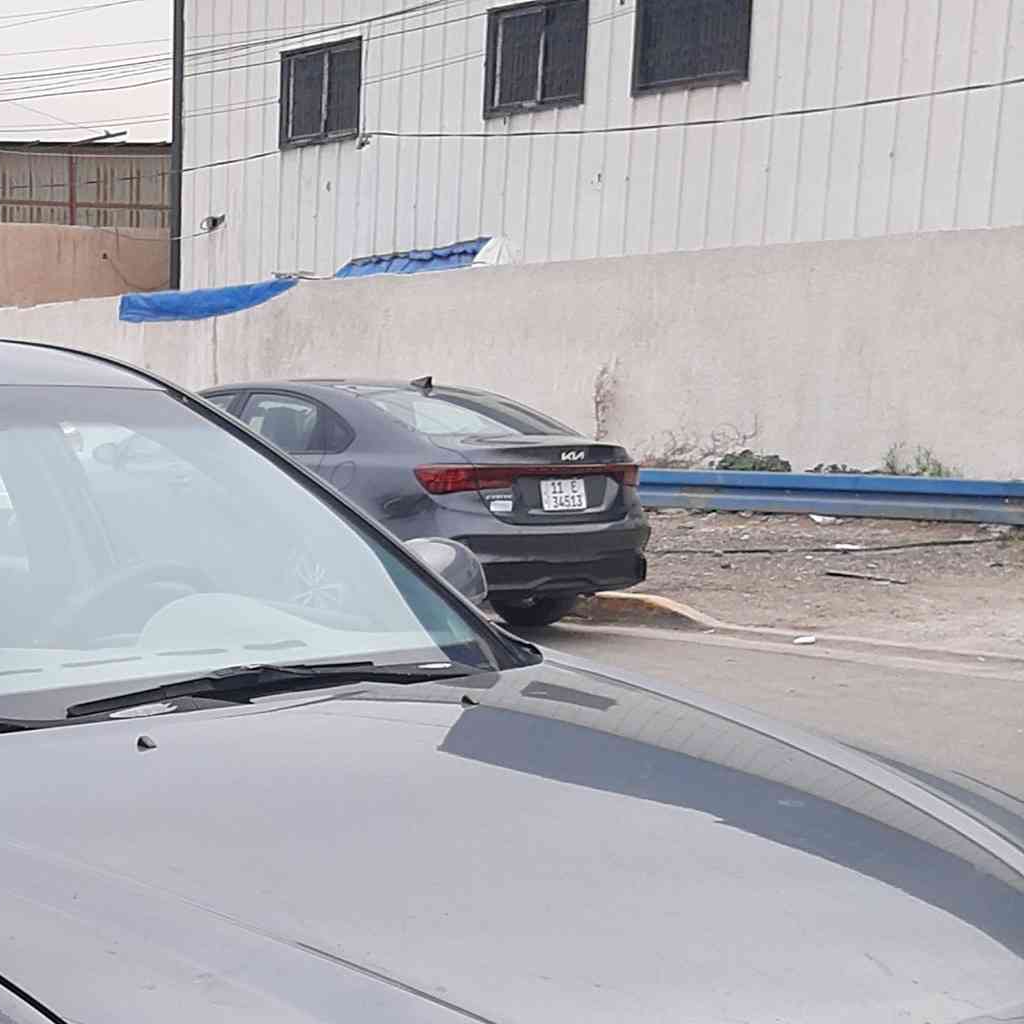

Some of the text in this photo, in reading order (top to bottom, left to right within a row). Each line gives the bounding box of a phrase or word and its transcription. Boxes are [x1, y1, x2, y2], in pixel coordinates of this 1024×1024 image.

[551, 481, 578, 494] 11 E
[552, 495, 583, 508] 34513
